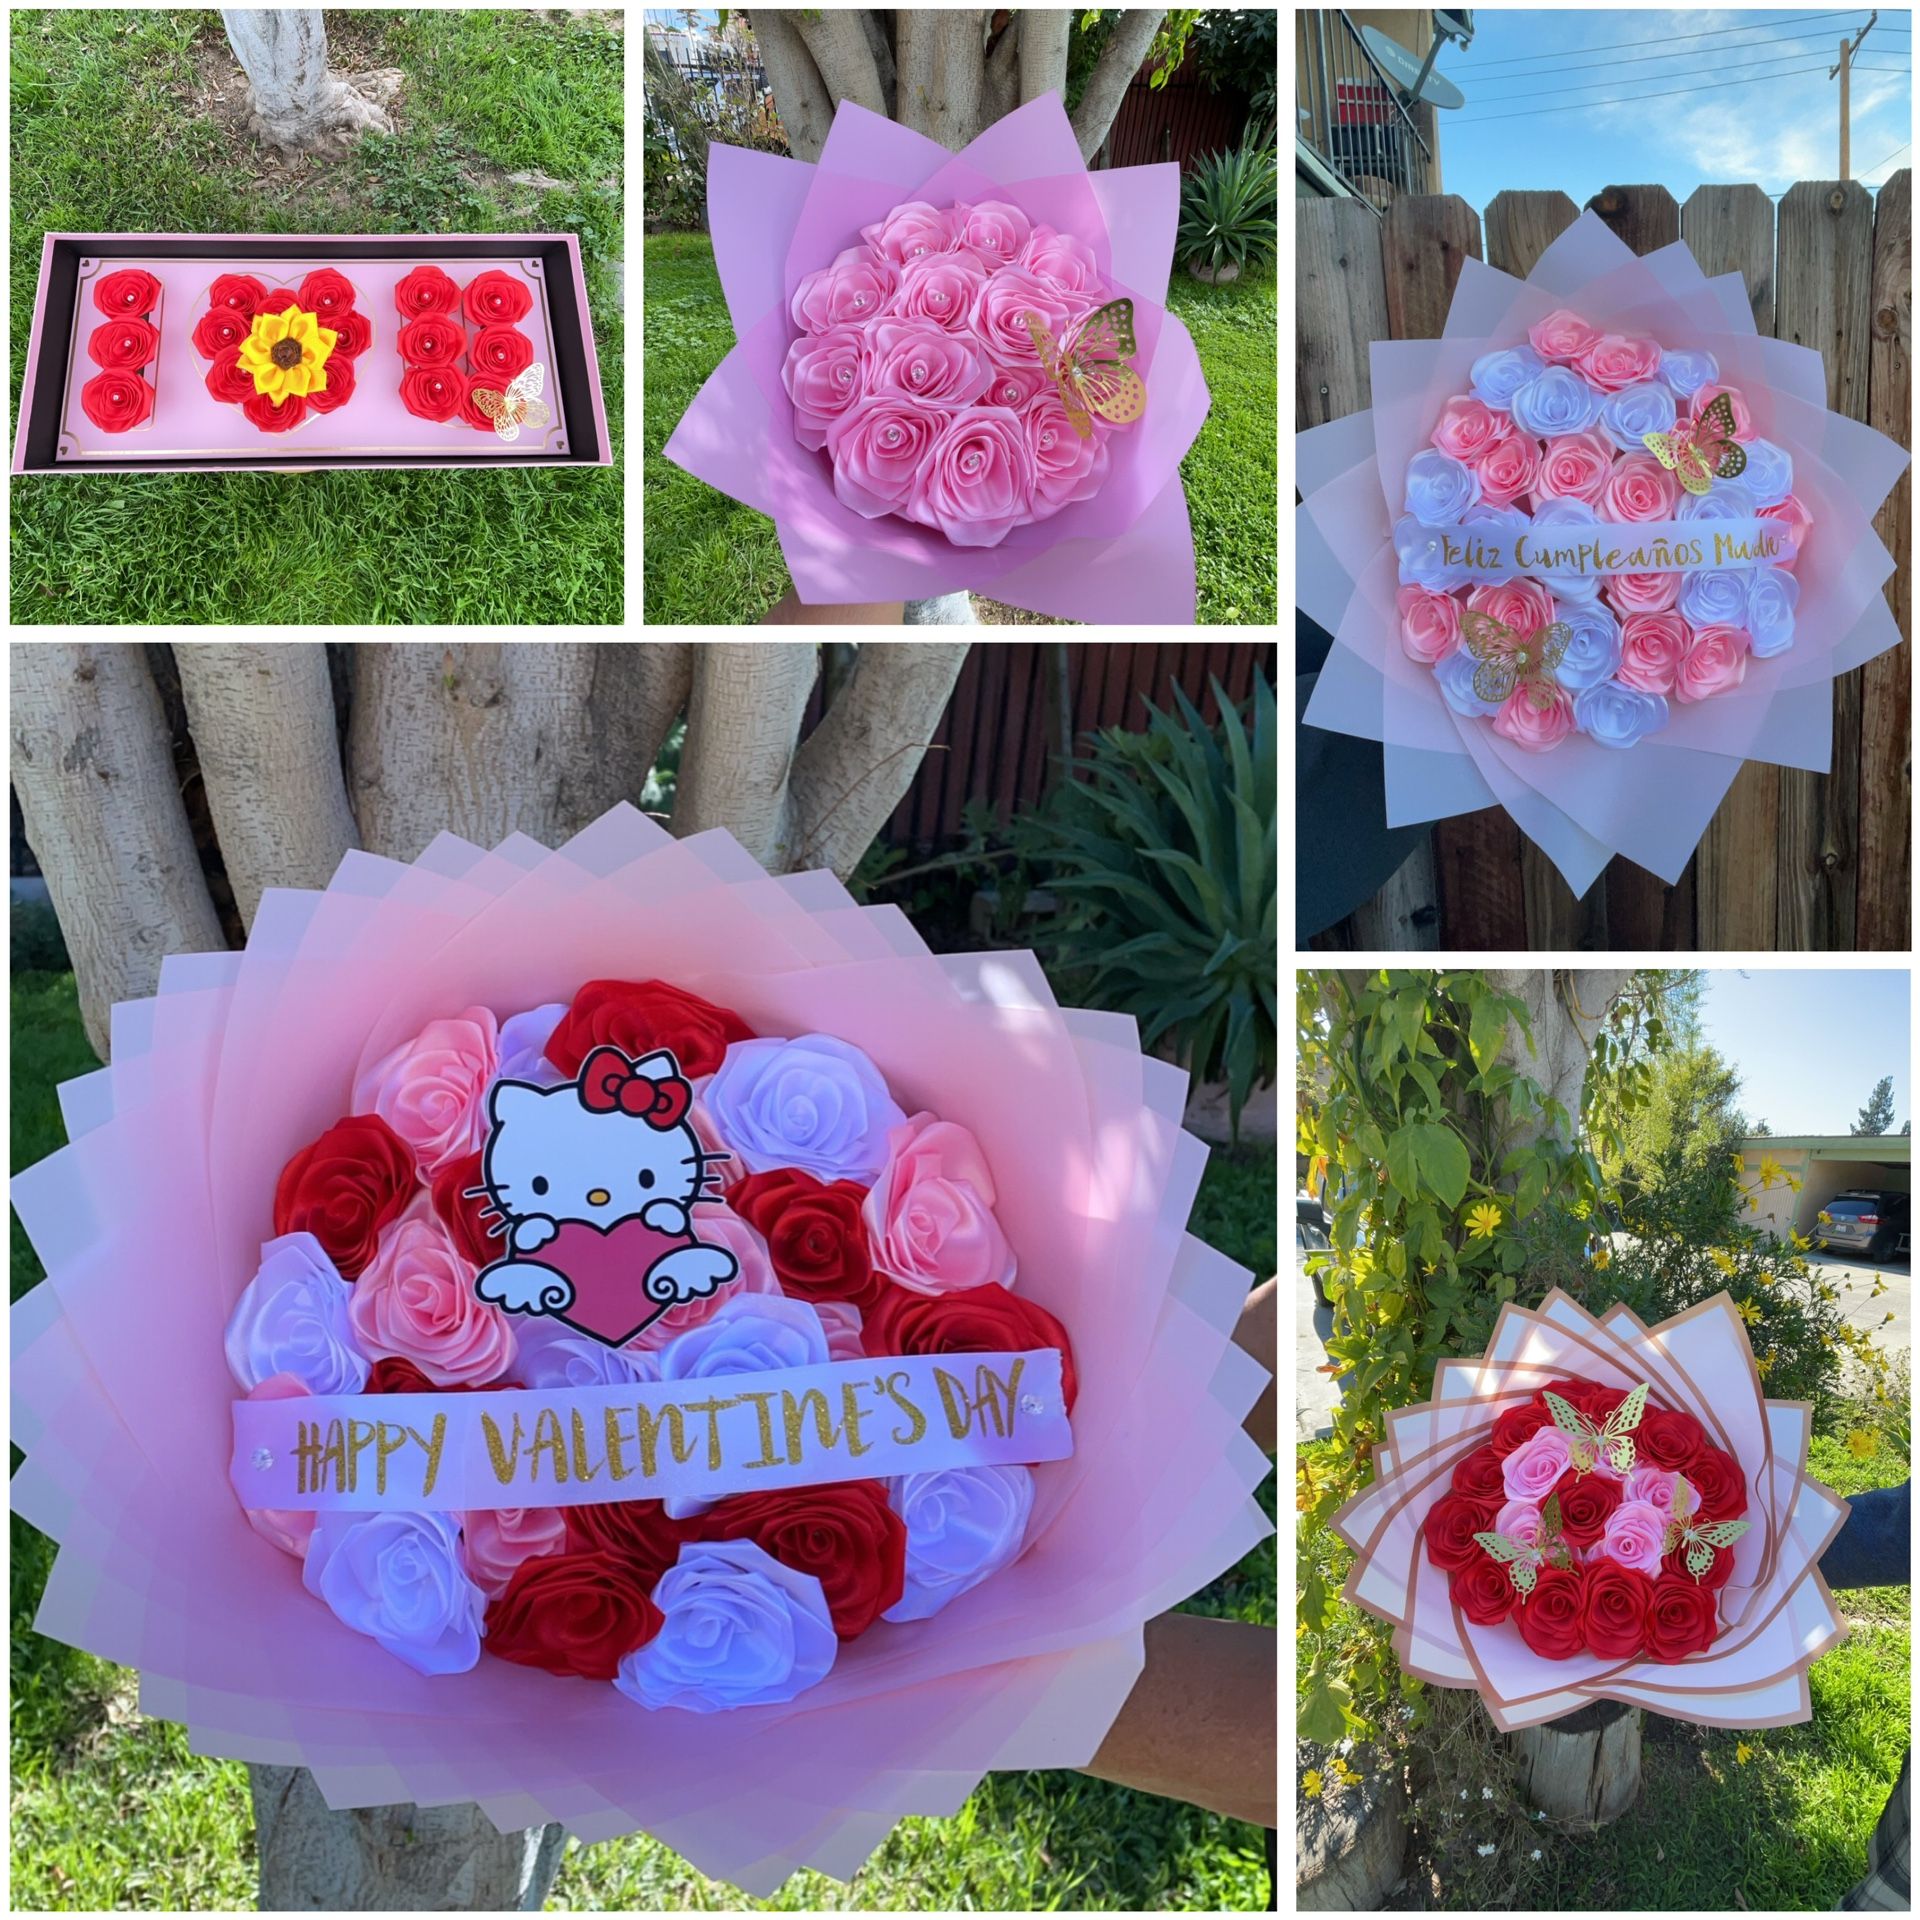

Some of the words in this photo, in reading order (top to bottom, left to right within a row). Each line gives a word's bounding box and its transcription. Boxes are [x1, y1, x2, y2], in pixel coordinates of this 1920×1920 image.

[1397, 56, 1440, 86] DIRETV
[1440, 534, 1503, 570] Feliz
[1514, 535, 1702, 575] Cumpleaños
[1713, 529, 1780, 567] Madre
[291, 1412, 447, 1497] HAPPY
[480, 1371, 928, 1486] VALENTINE'S
[933, 1356, 1027, 1442] DAY
